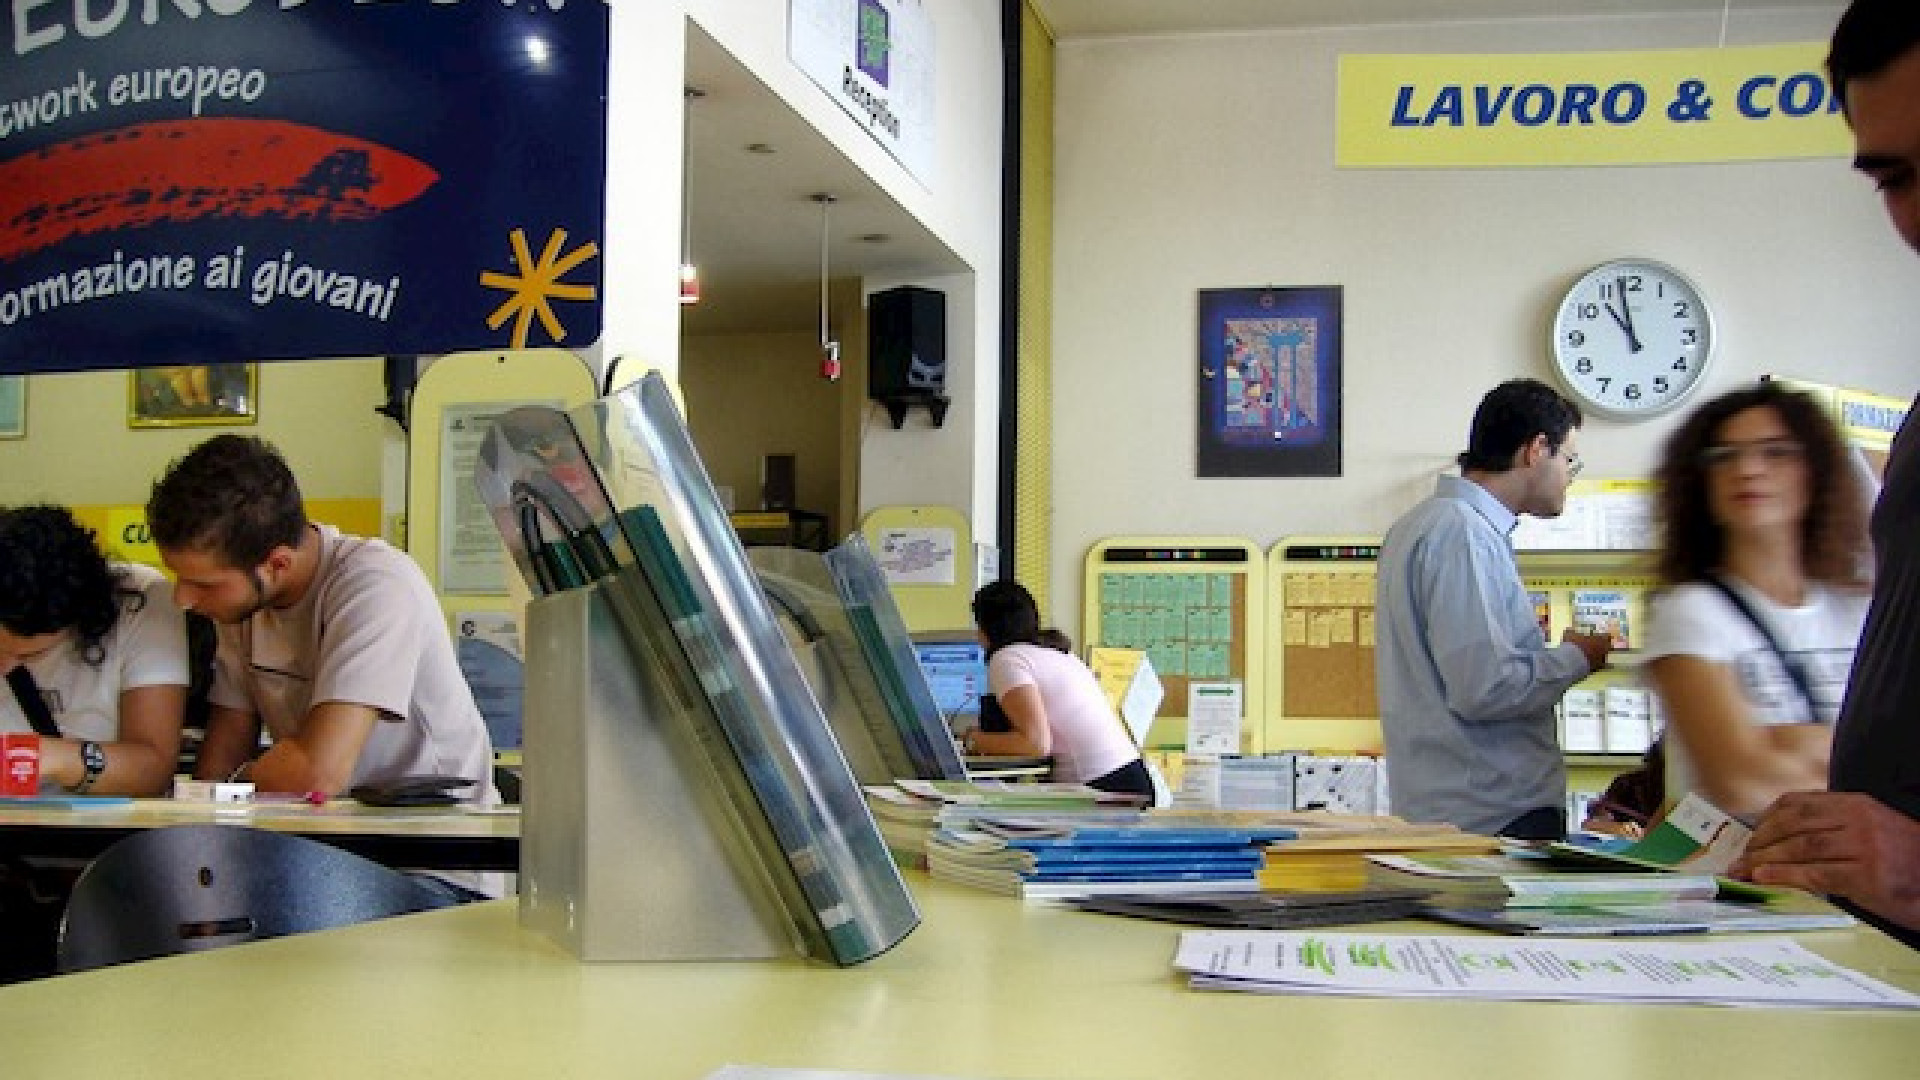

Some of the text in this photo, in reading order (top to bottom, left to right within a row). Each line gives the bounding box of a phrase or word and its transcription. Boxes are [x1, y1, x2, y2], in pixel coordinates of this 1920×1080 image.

[109, 65, 266, 117] europeo
[843, 65, 900, 140] Reception
[1390, 73, 1842, 128] LAVORO & CO
[0, 246, 400, 325] ormazione ai giovani
[1577, 303, 1599, 320] 10
[1674, 302, 1690, 319] 2
[1568, 330, 1585, 348] 9
[1682, 329, 1697, 346] 3
[1575, 356, 1593, 375] 8
[1672, 356, 1687, 372] 4
[1596, 377, 1612, 394] 7
[1624, 383, 1642, 400] 6
[1653, 376, 1669, 394] 5
